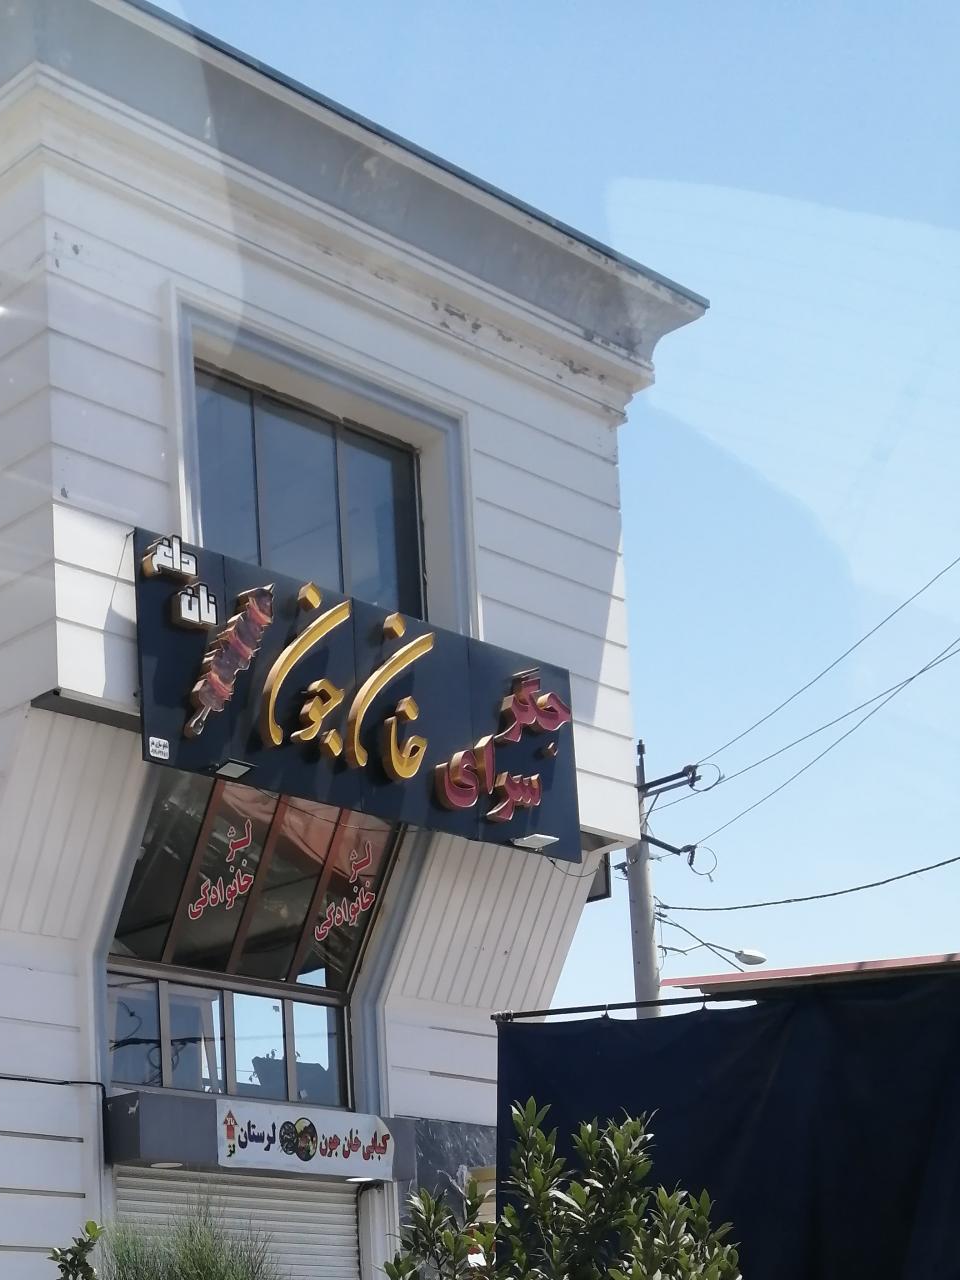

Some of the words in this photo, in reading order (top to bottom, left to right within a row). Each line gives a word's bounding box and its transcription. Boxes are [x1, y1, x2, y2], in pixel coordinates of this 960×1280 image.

[145, 533, 198, 577] داغ
[175, 581, 219, 626] نان
[263, 581, 351, 757] جون
[347, 611, 435, 780] خان
[436, 734, 542, 821] سرای
[226, 819, 253, 862] لژ
[349, 840, 372, 883] لژ
[188, 858, 255, 920] خانوادگی
[314, 880, 376, 942] خانوادگی
[238, 1119, 276, 1151] لرستان
[319, 1133, 341, 1158] جون
[342, 1127, 361, 1159] خان
[362, 1129, 391, 1161] کبابی
